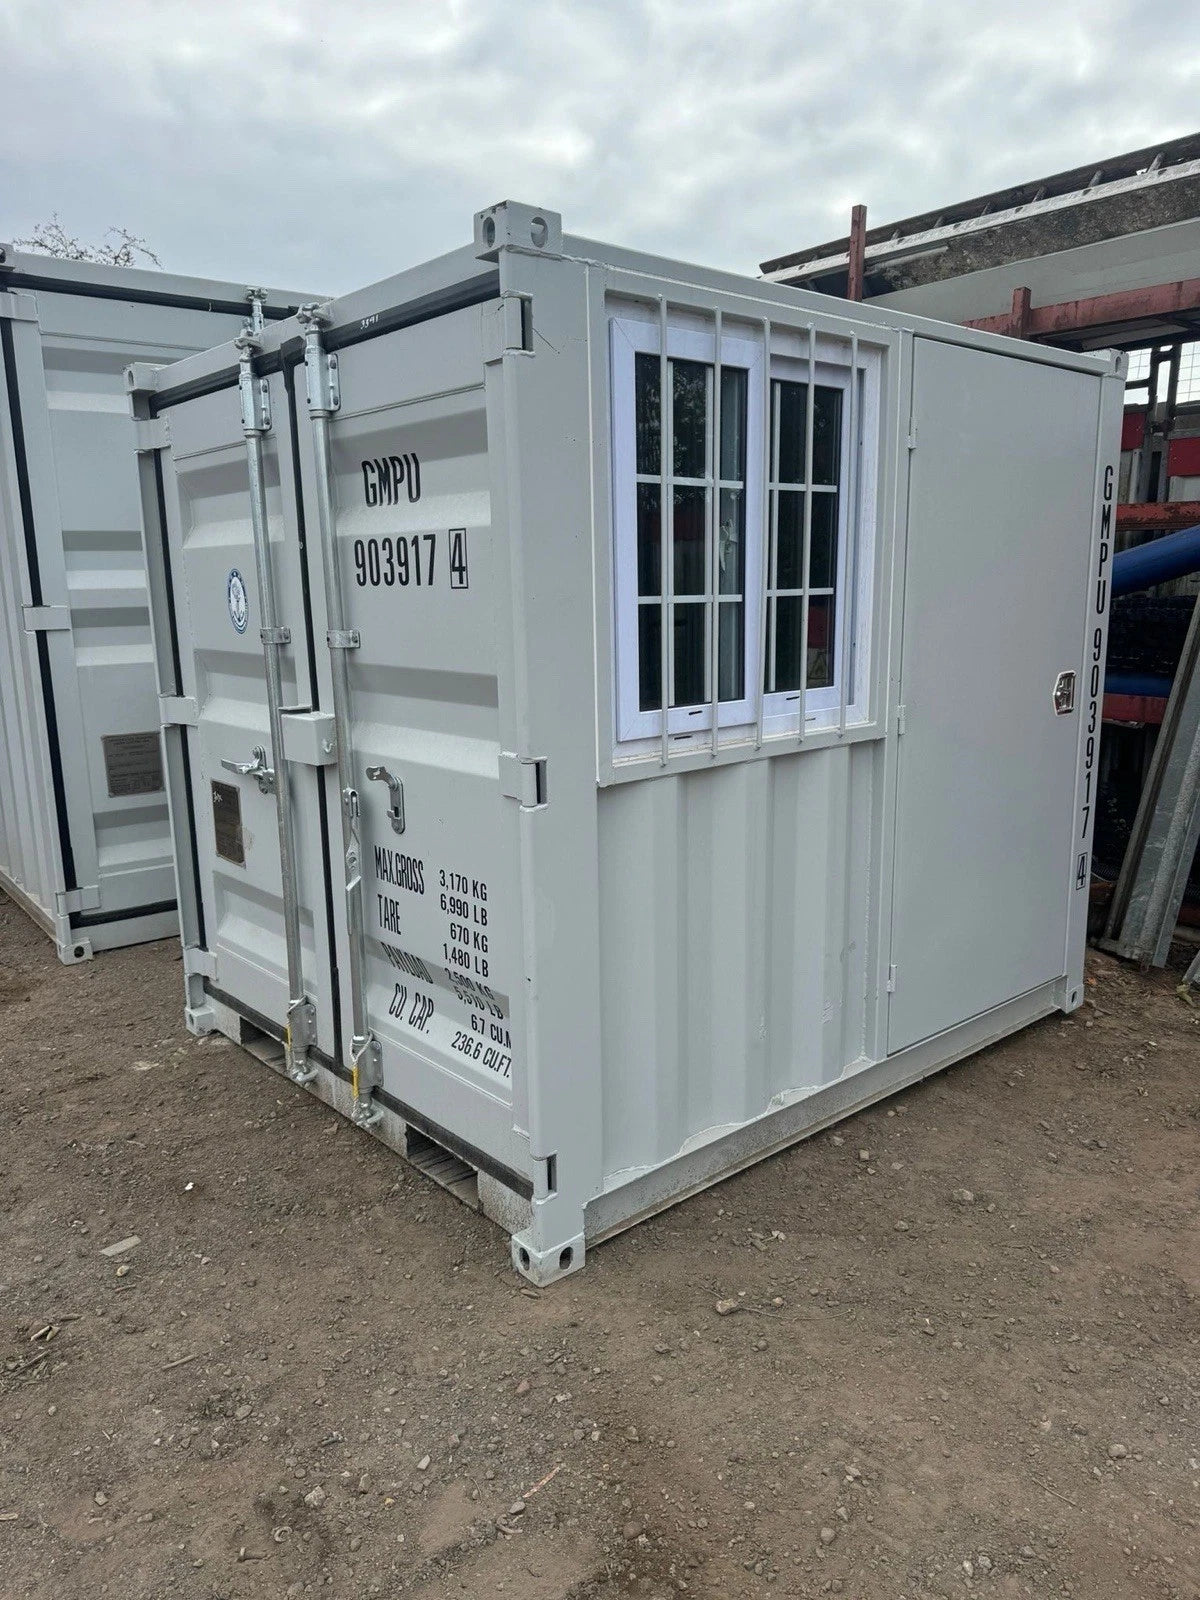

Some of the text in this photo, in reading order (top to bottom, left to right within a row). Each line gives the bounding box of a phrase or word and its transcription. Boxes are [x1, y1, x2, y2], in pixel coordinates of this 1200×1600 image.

[361, 452, 421, 508] GMPU
[354, 531, 467, 587] 903917 4
[1096, 465, 1114, 615] GMPU
[1076, 628, 1102, 888] 903917 4
[374, 845, 425, 895] MAX.GROSS
[439, 869, 488, 902] 3,170 KG
[377, 893, 402, 935] TARE
[440, 893, 488, 926] 6,990 LB
[450, 922, 489, 953] 670 KG
[443, 943, 489, 978] 1,480 LB
[388, 982, 434, 1034] CU. CAP.
[453, 985, 504, 1020] 5,510 LB
[471, 1013, 485, 1035] 6.7
[451, 1031, 483, 1060] 236.6
